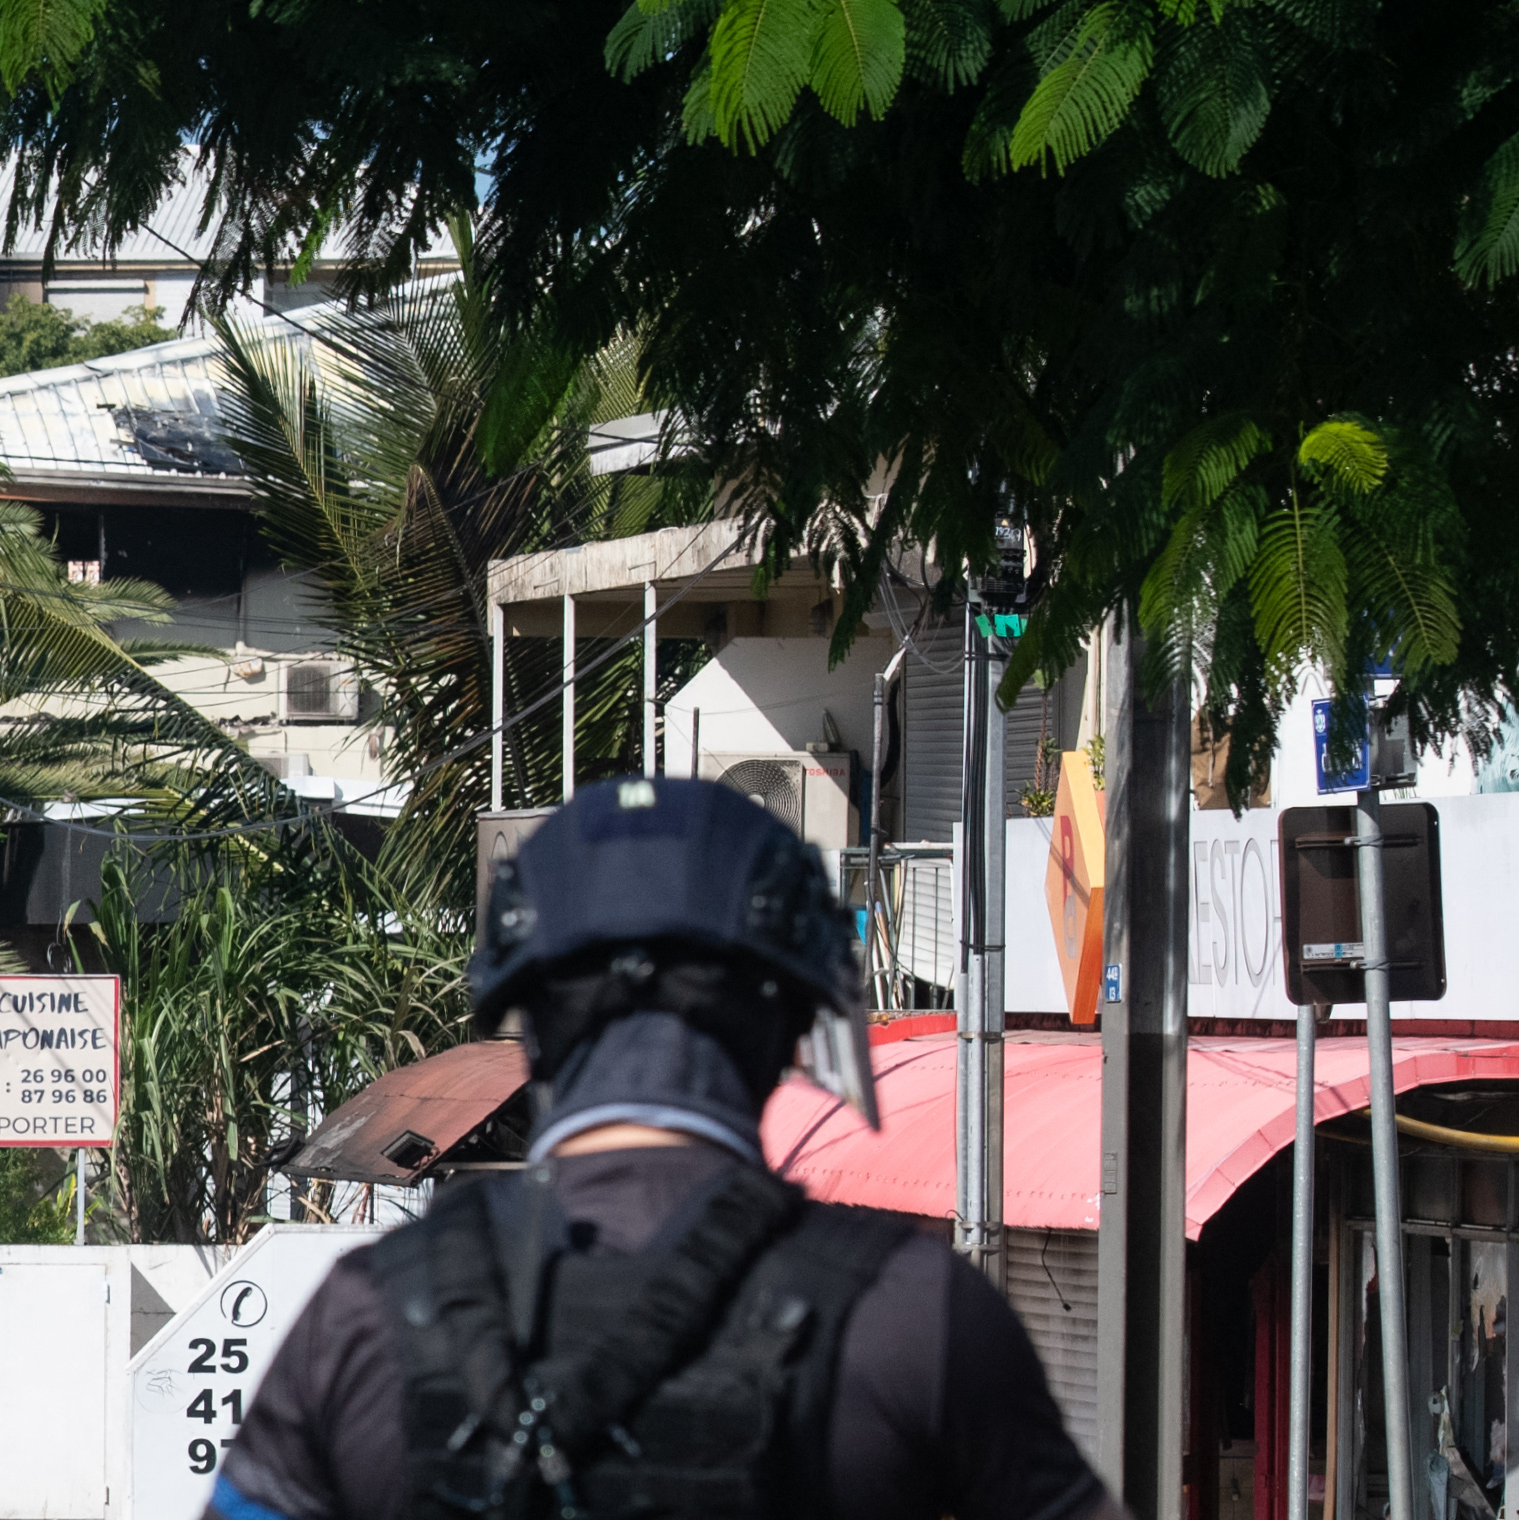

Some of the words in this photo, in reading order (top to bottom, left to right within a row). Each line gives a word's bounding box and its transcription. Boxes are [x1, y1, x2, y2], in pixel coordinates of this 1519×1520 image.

[804, 768, 846, 776] TOSHIBA
[1188, 838, 1281, 988] ESTO
[20, 1069, 44, 1084] 26
[51, 1069, 75, 1084] 96
[82, 1068, 107, 1084] 00
[21, 1089, 44, 1104] 87
[51, 1089, 76, 1104] 96
[82, 1089, 107, 1104] 86
[187, 1337, 249, 1374] 25
[186, 1388, 243, 1425] 41
